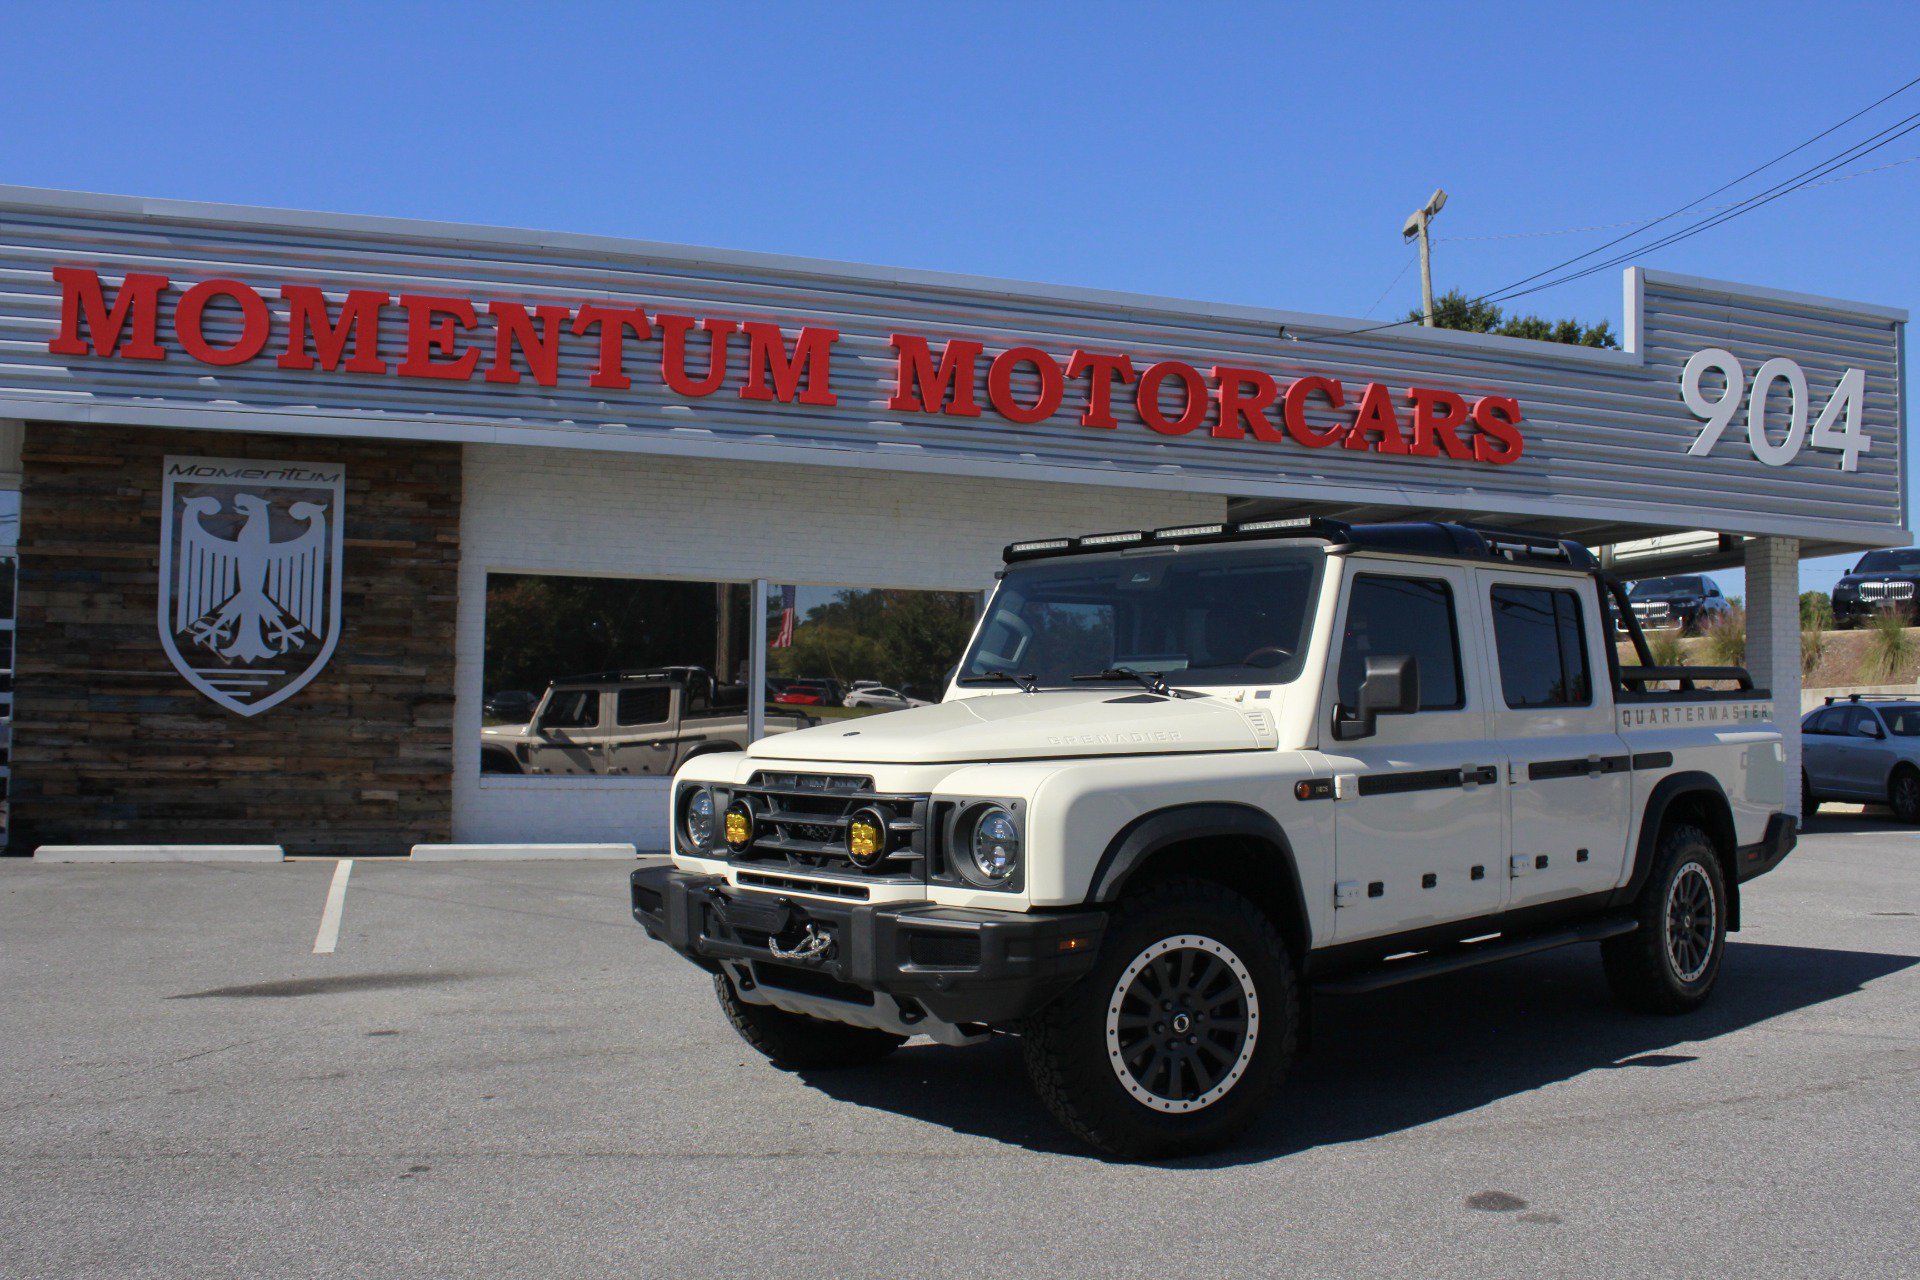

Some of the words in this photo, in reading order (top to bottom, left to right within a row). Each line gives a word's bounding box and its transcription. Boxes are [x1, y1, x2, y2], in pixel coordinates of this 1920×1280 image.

[49, 267, 838, 405] MOMENTUM
[888, 333, 1524, 465] MOTORCARS
[1682, 348, 1871, 472] 904
[1047, 730, 1182, 746] GRENADIER
[1622, 704, 1769, 727] QUARTERMASTER
